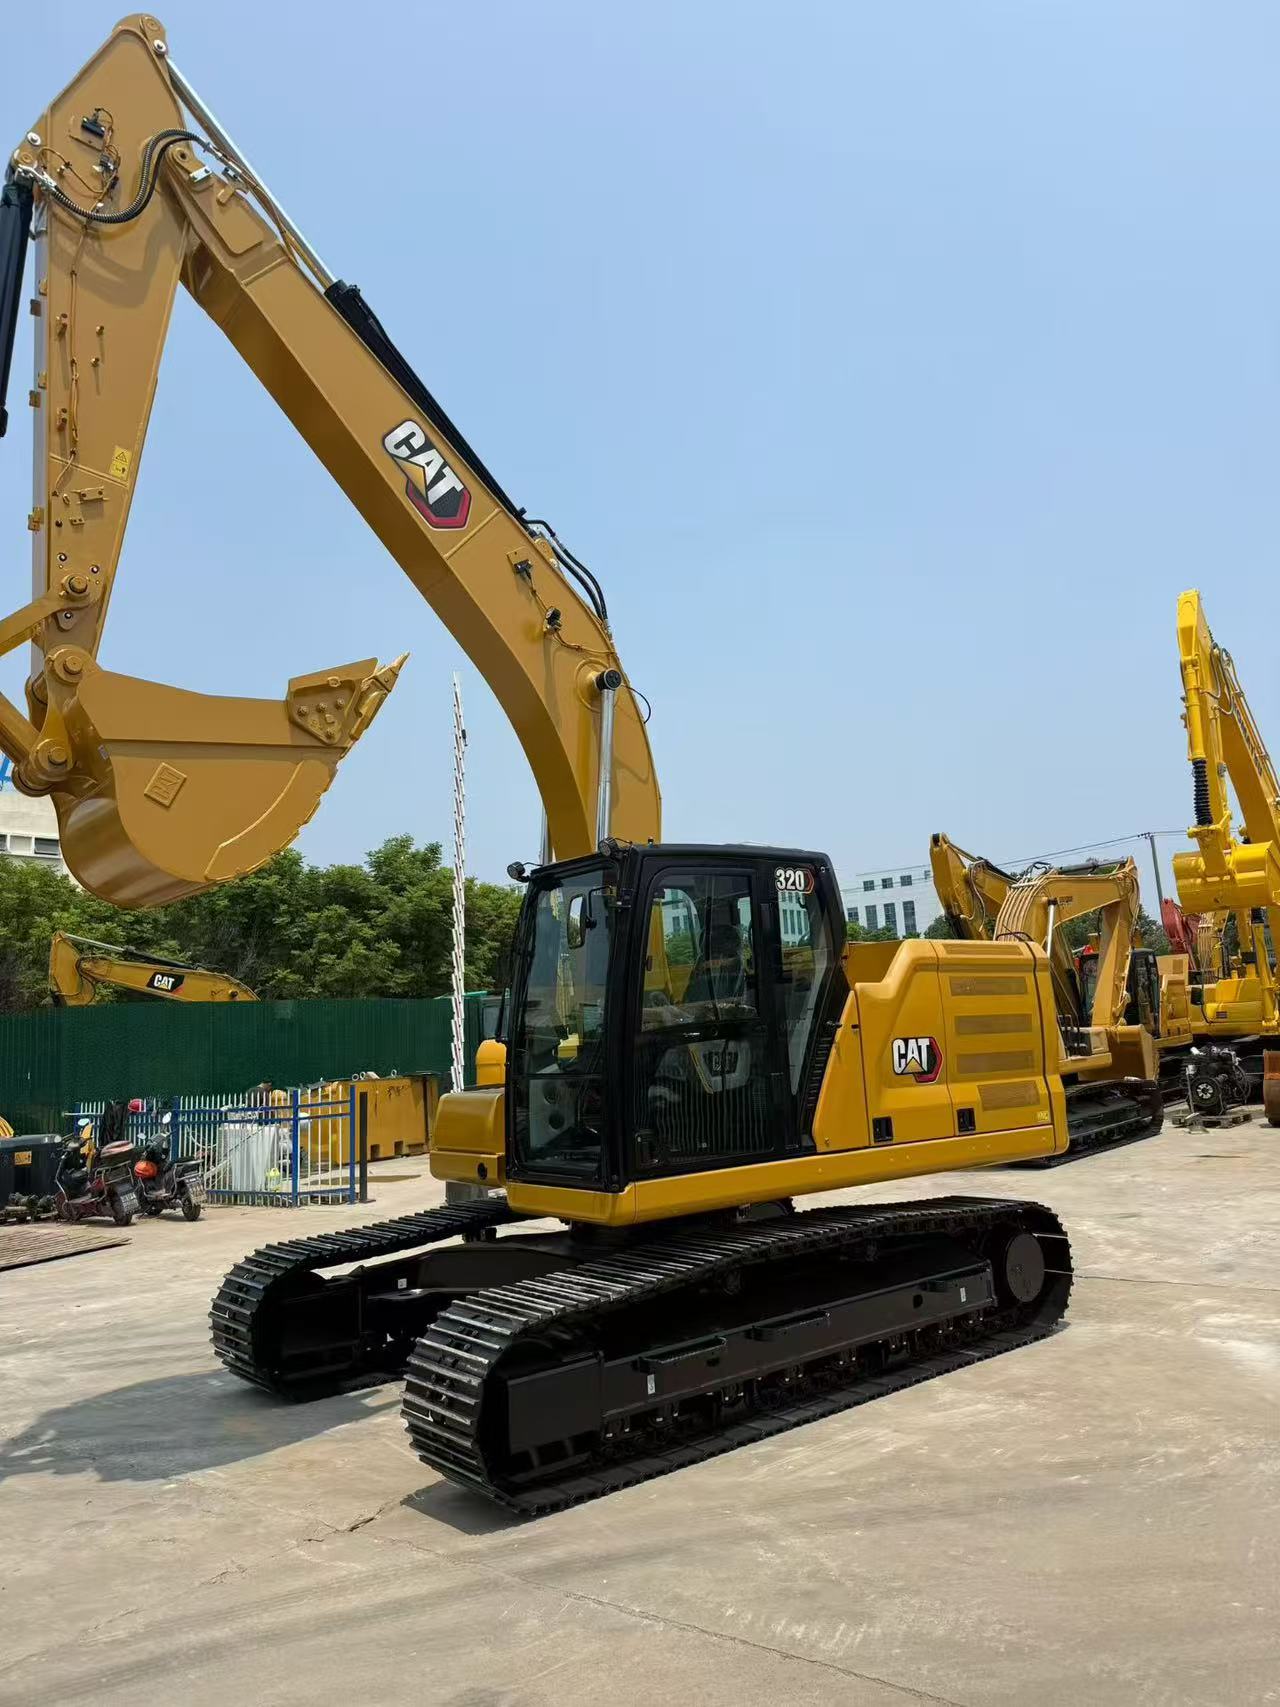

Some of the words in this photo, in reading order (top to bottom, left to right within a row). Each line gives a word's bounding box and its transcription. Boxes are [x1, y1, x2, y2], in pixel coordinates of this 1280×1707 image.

[384, 420, 465, 505] CAT
[776, 869, 805, 891] 320
[154, 974, 175, 990] CAT
[892, 1038, 930, 1074] CAT
